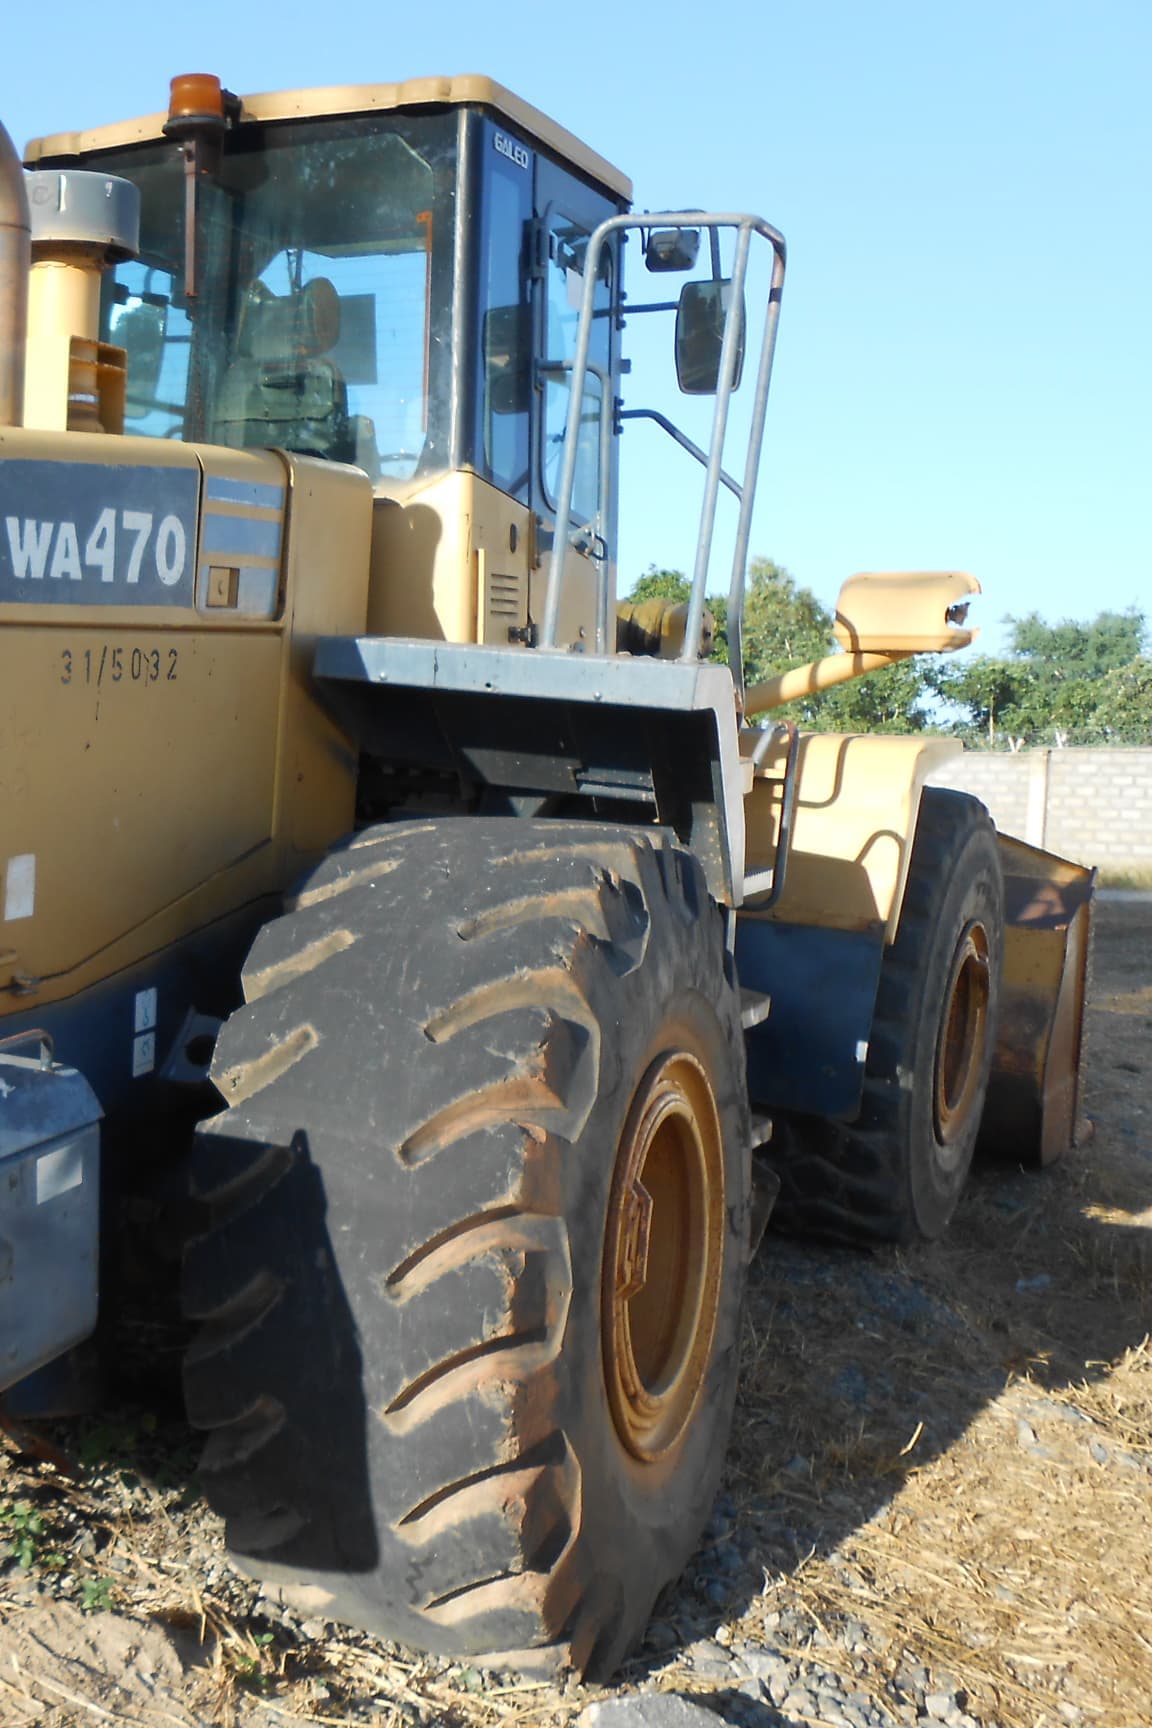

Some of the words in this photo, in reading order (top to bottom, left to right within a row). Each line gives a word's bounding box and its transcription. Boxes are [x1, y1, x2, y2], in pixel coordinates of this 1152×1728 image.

[494, 132, 528, 169] GALEO
[5, 508, 186, 586] WA470
[60, 645, 178, 686] 31/5032
